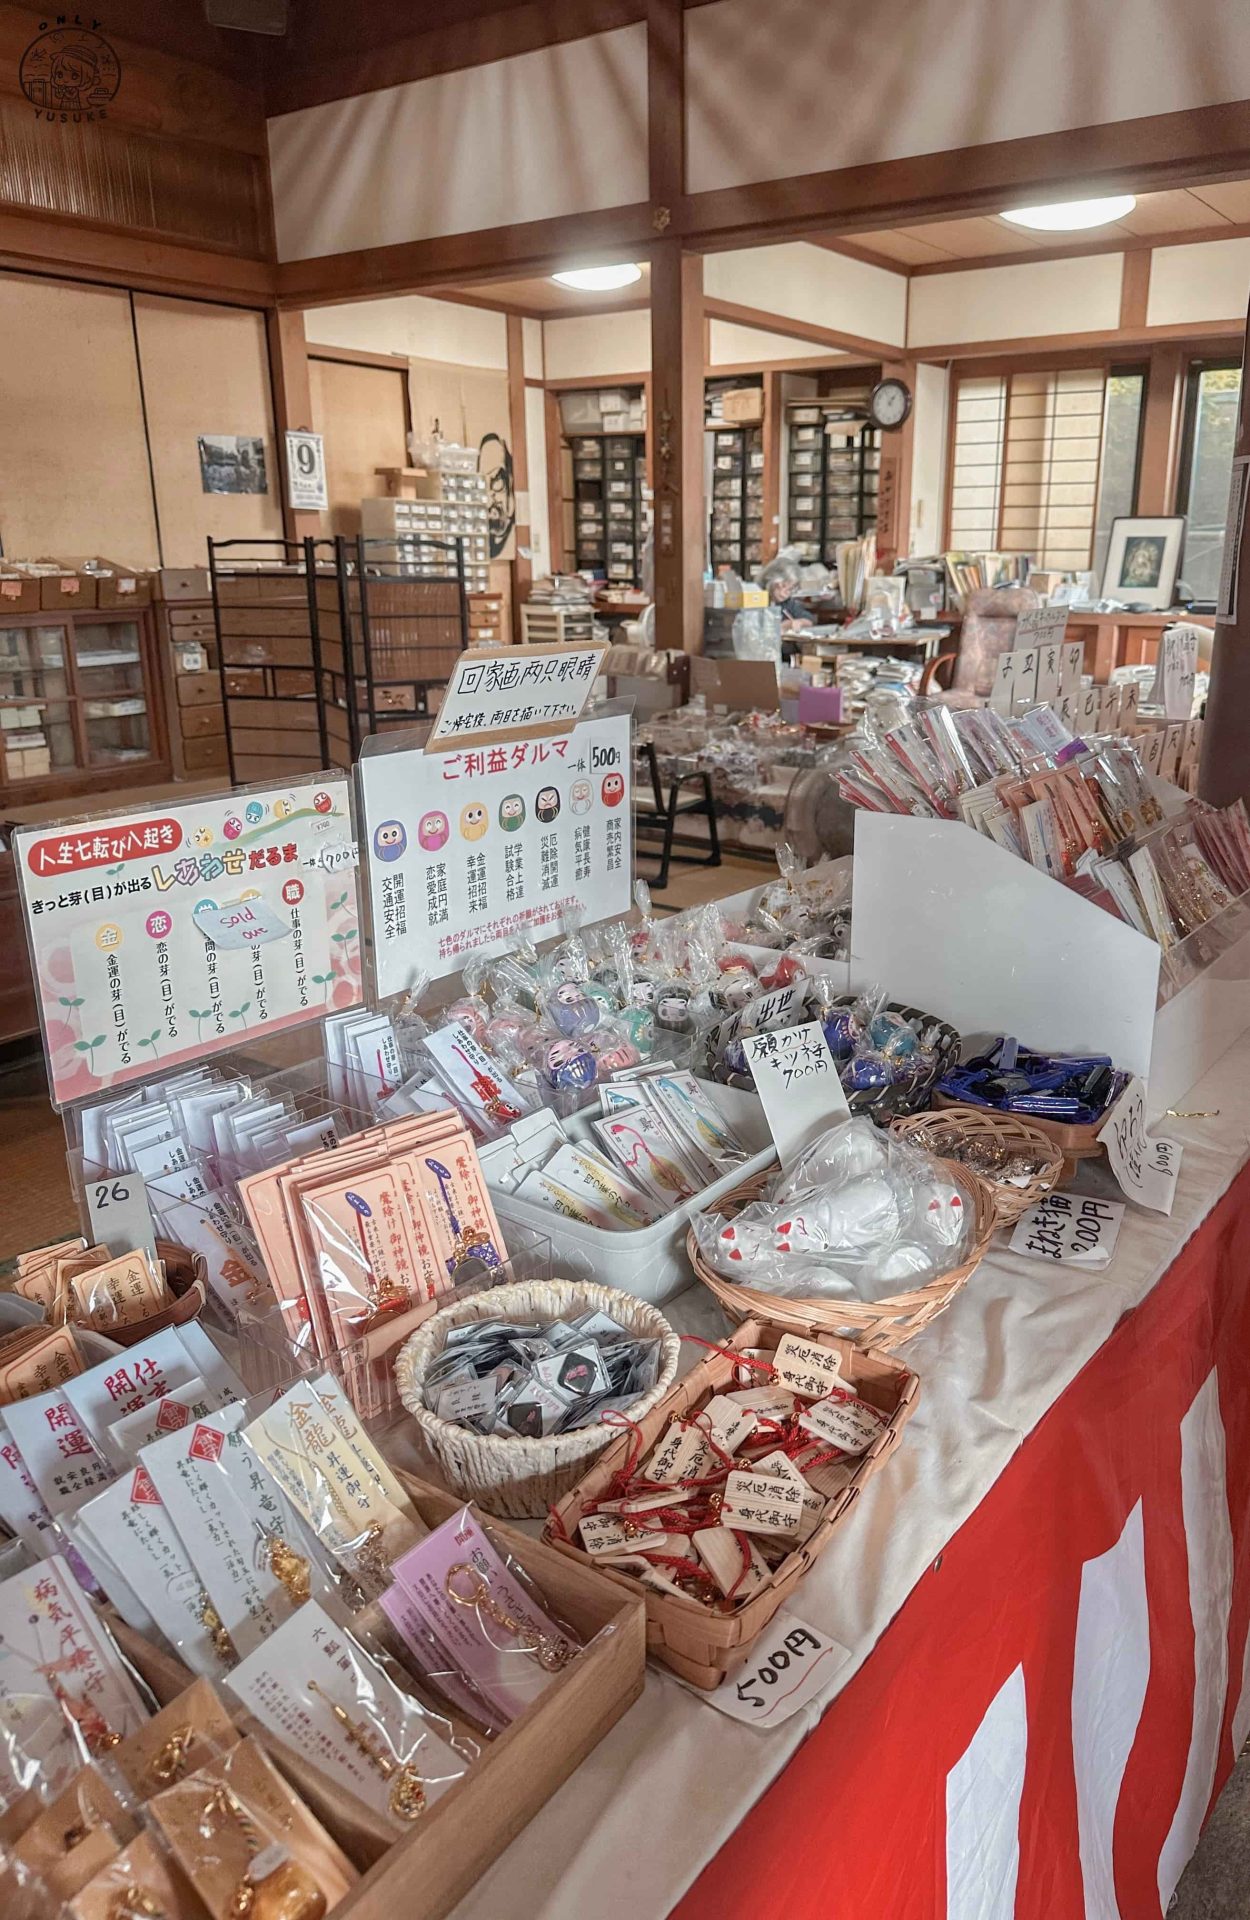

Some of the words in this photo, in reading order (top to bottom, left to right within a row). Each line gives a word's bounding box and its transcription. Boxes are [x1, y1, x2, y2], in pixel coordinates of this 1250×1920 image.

[297, 444, 315, 474] 9
[1002, 656, 1013, 678] 子
[1022, 653, 1034, 675] 丑
[1047, 648, 1056, 675] 寅
[1069, 648, 1080, 674] 卯
[443, 740, 569, 780] ご利益ダルマ
[568, 758, 586, 772] 一体
[39, 824, 174, 871] 人生七転び八起き
[549, 833, 558, 888] 厄除開運
[582, 825, 591, 878] 健康長寿
[466, 855, 478, 913] 幸運招来
[476, 852, 487, 910] 金運招福
[504, 844, 515, 902] 試験合格
[514, 842, 524, 899] 学業上達
[286, 884, 301, 901] 職
[382, 877, 395, 940] 交通安全
[393, 873, 407, 936] 開運招福
[426, 865, 438, 927] 恋愛成就
[436, 862, 449, 923] 家庭円満
[150, 916, 168, 934] 恋
[755, 989, 796, 1027] 出世
[783, 1059, 828, 1089] 700円
[96, 1182, 130, 1209] 26
[1026, 1195, 1073, 1259] まねき猫
[126, 1269, 150, 1317] 金運くる
[54, 1351, 74, 1379] 金運
[784, 1343, 838, 1372] 災厄消除
[782, 1370, 829, 1395] 身代御守
[44, 1402, 96, 1459] 開運
[651, 1436, 683, 1482] 身代御守
[735, 1479, 802, 1505] 災厄消除
[737, 1506, 799, 1528] 身代御守
[736, 1626, 822, 1708] 500円
